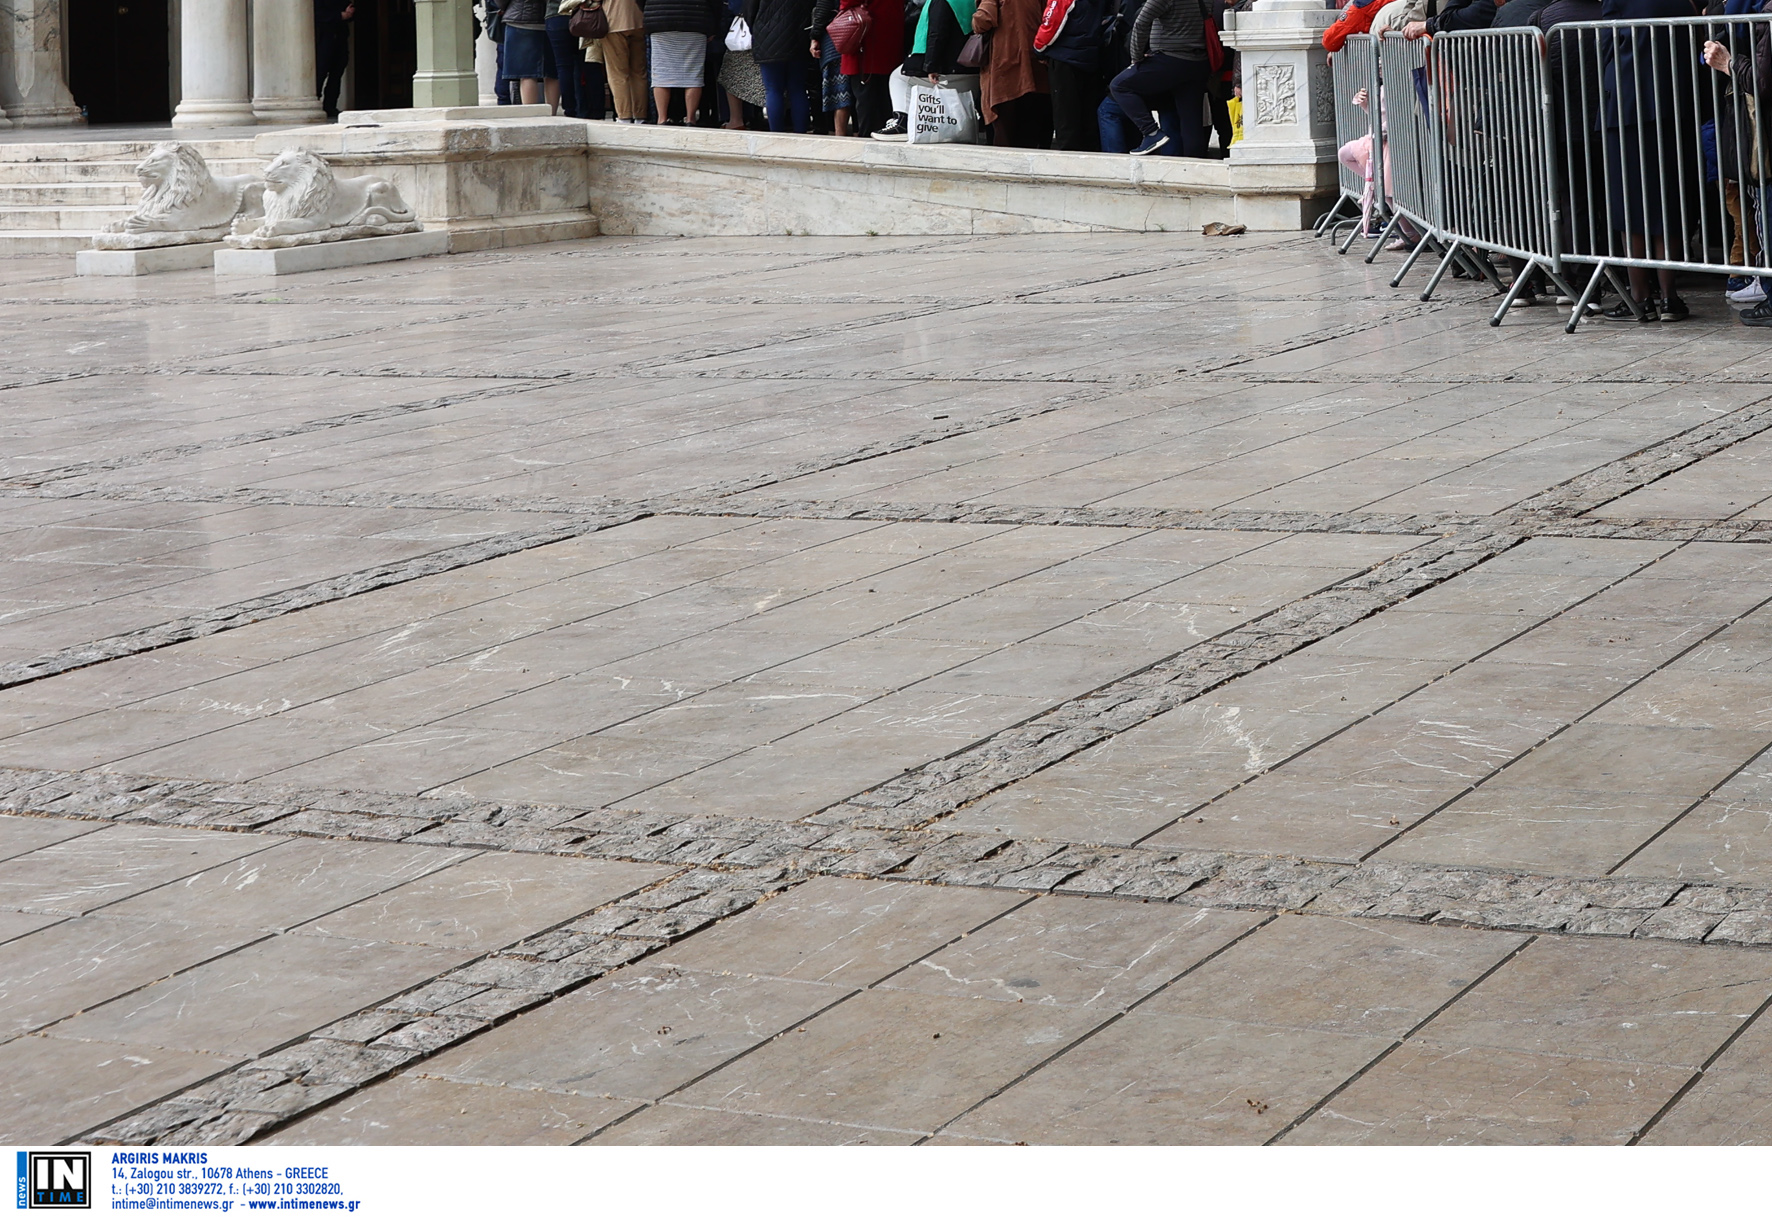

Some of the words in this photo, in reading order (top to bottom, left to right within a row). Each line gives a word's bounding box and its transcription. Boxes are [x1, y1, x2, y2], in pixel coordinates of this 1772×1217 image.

[918, 93, 941, 104] Gifts
[918, 105, 945, 114] you'll
[918, 114, 945, 124] want
[947, 115, 957, 125] to
[916, 122, 939, 133] give
